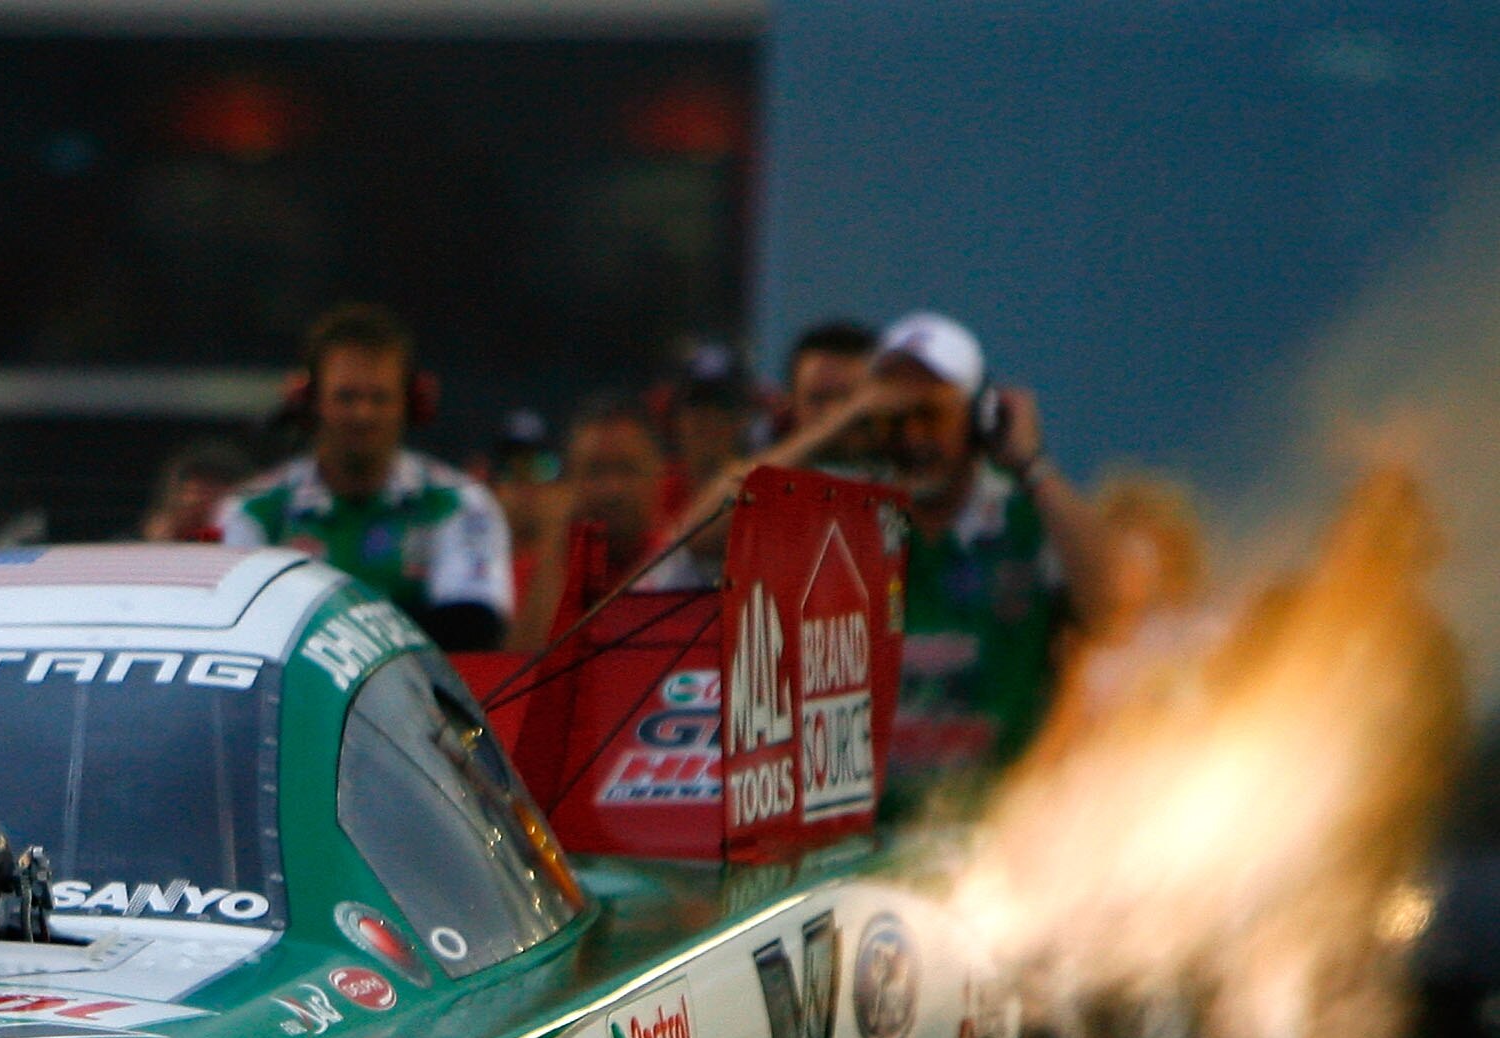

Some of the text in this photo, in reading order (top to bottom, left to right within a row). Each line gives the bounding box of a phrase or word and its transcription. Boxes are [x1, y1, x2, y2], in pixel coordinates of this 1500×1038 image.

[729, 582, 794, 757] MAC
[803, 611, 870, 698] BRAND
[731, 756, 796, 827] TOOLS
[52, 879, 269, 919] SANYO
